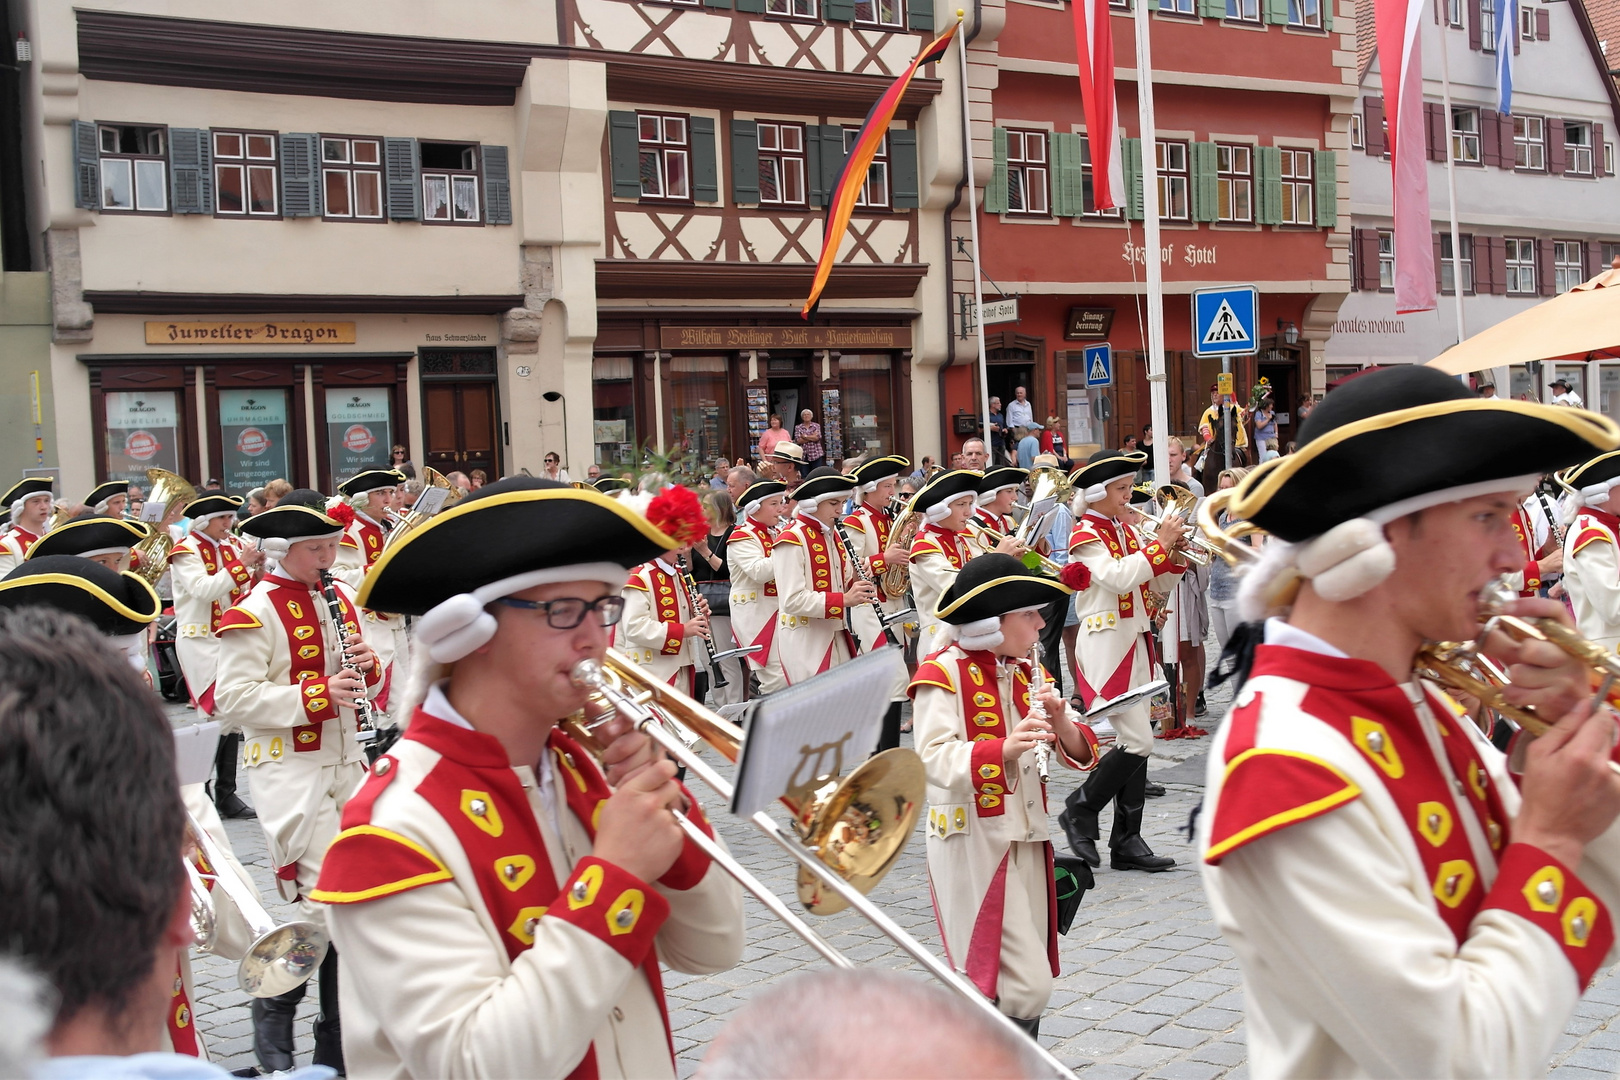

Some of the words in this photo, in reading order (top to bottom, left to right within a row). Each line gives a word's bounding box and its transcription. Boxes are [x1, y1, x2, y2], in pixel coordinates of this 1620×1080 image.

[1122, 241, 1174, 266] Hezof
[1184, 244, 1217, 267] Hotel
[998, 304, 1014, 317] Hotel
[1082, 312, 1105, 322] Finanz-
[1075, 321, 1103, 331] beratung
[167, 324, 253, 341] Juwelier
[265, 324, 338, 344] Dragon
[425, 333, 442, 342] Haus
[681, 329, 722, 346] Wilhelm
[254, 459, 270, 467] sind
[360, 455, 374, 463] sind
[234, 469, 277, 478] umgezogen:
[229, 480, 263, 488] Segringer
